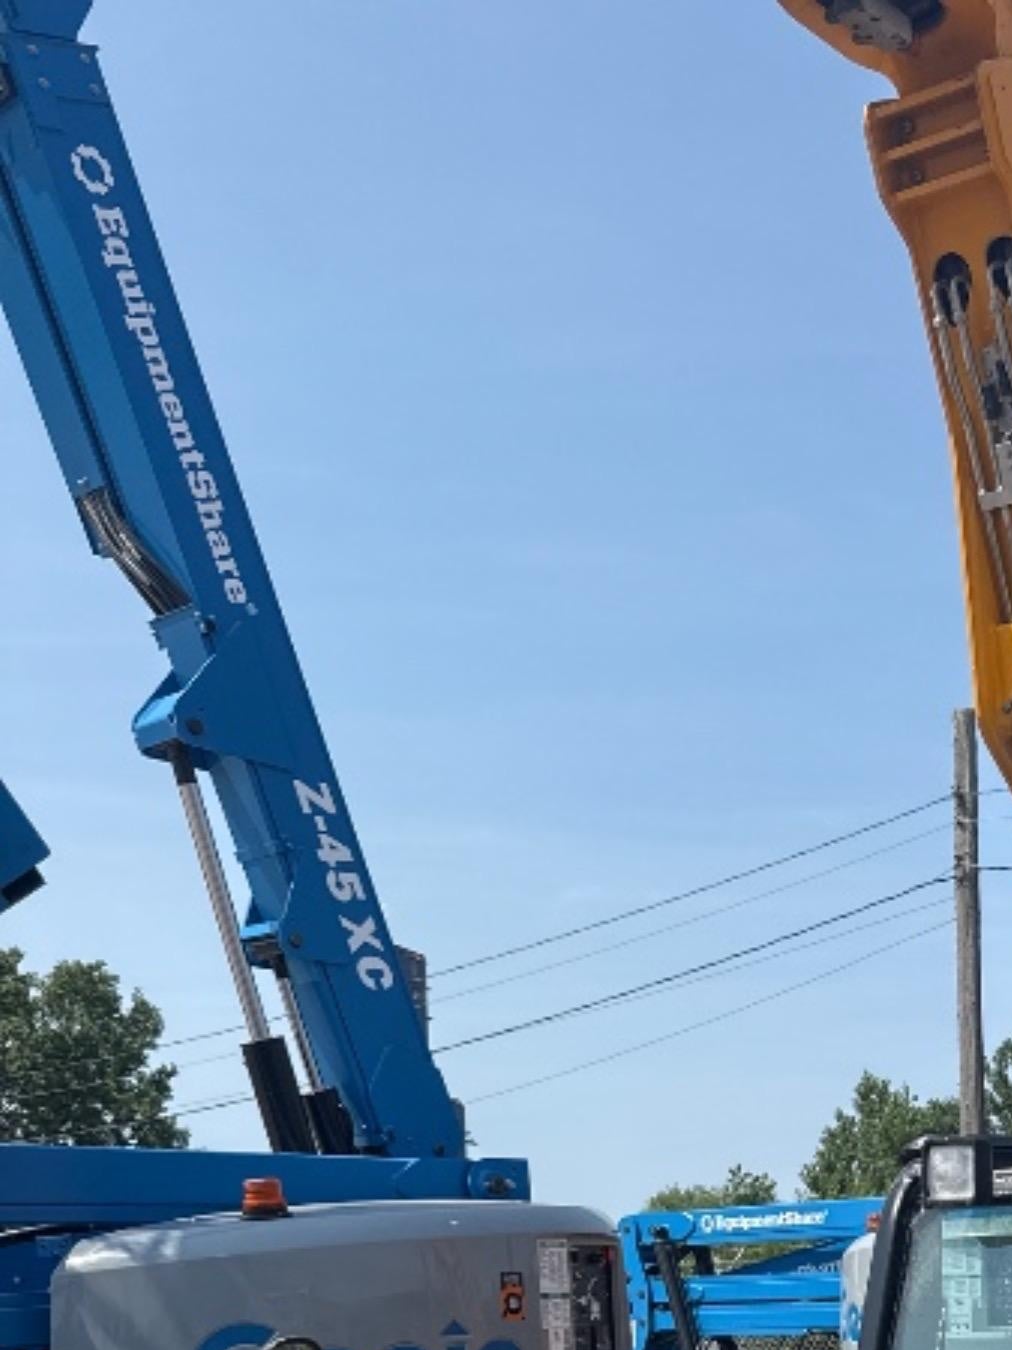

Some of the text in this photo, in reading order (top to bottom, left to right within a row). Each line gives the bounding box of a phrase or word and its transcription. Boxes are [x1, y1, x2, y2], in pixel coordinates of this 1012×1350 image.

[92, 203, 248, 605] EquipmentShare
[294, 778, 395, 993] Z-45 XC
